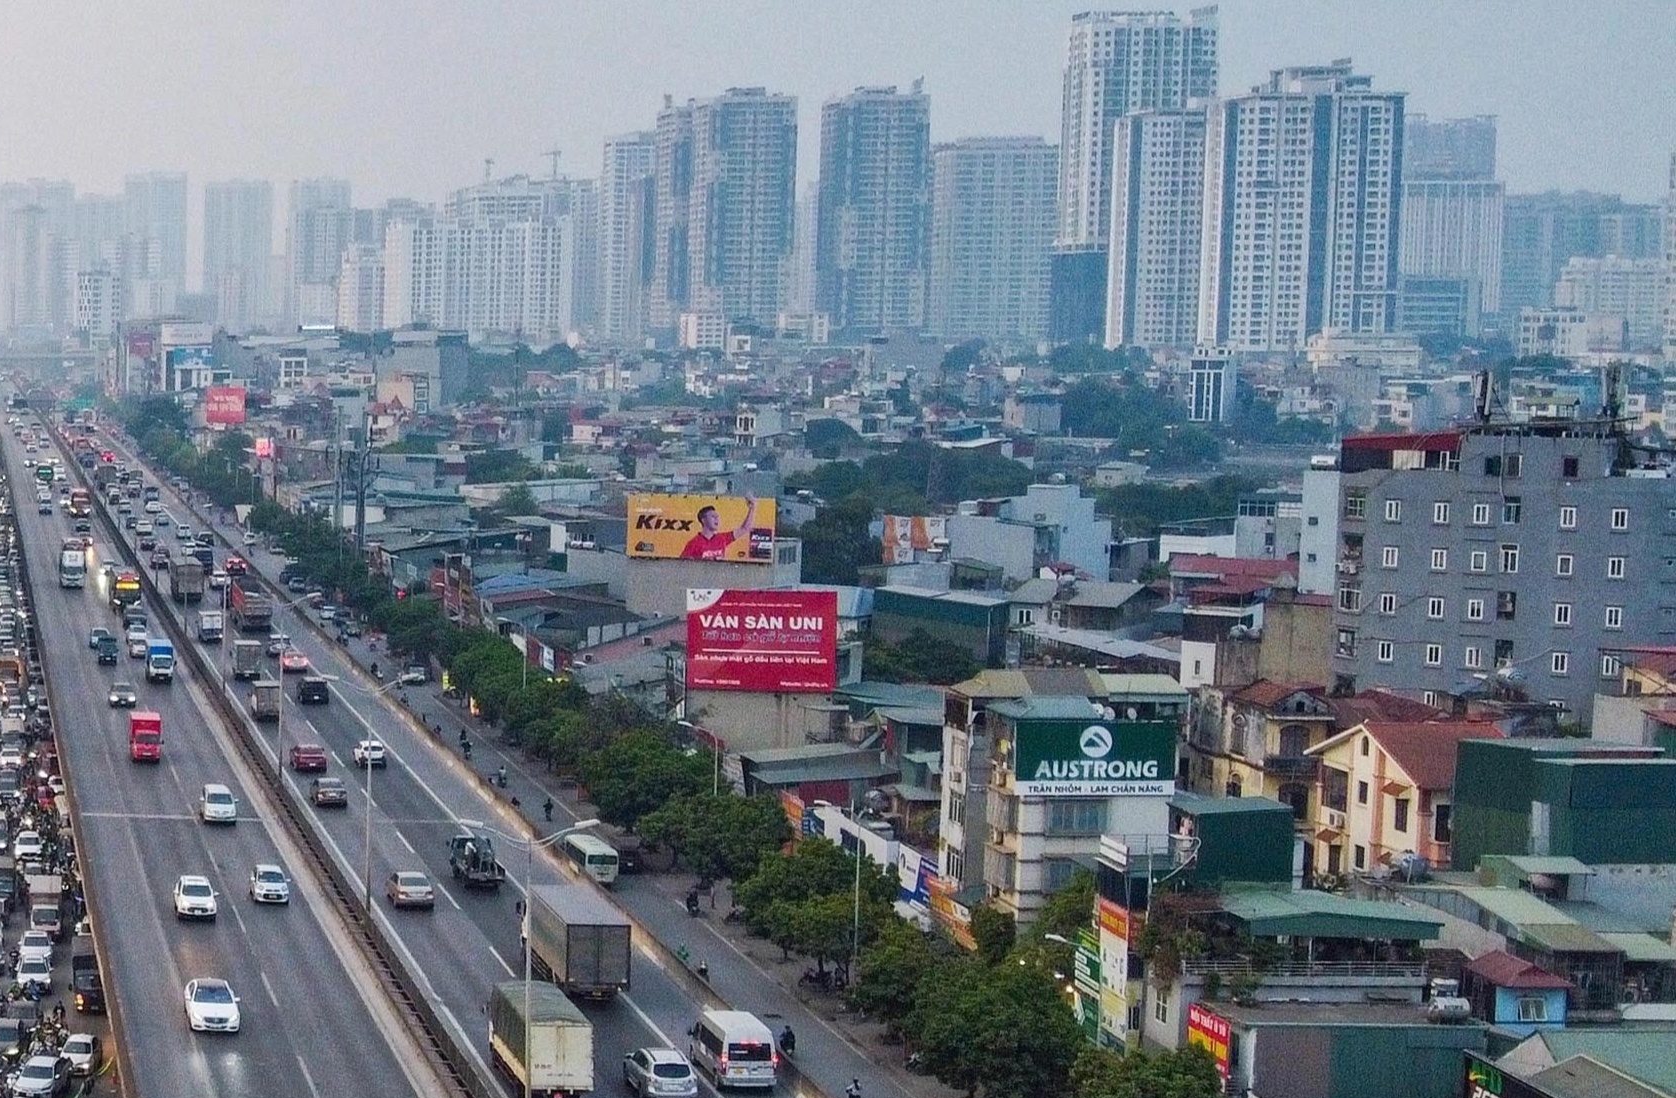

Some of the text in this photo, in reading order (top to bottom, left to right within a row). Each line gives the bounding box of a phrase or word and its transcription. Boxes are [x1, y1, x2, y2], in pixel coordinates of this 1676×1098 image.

[636, 515, 694, 531] Kixx
[699, 613, 823, 631] VÁN SÀN UNI
[1035, 760, 1159, 778] AUSTRONG
[1090, 784, 1110, 793] LAM
